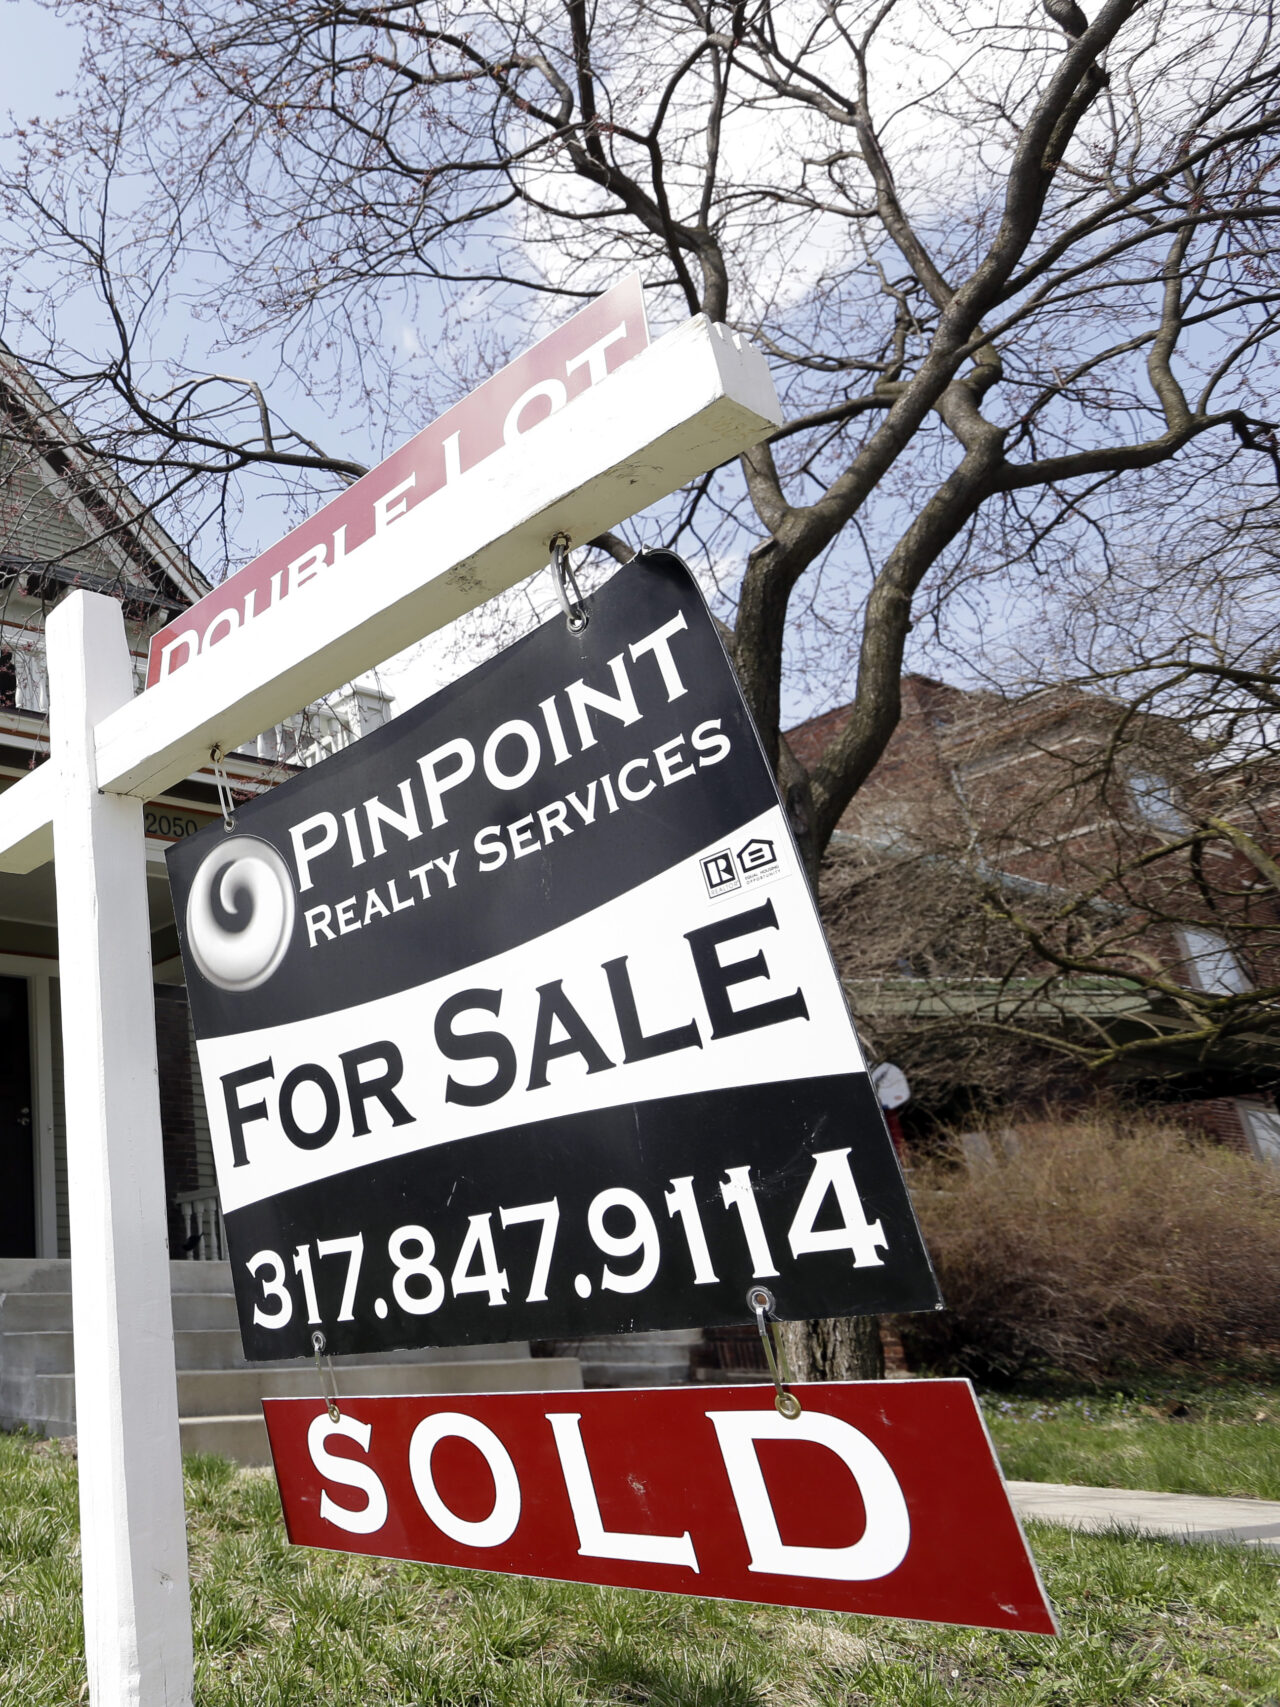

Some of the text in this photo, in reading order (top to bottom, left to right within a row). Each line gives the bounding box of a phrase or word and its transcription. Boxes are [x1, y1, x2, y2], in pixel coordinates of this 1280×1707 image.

[145, 812, 198, 838] 2050
[288, 609, 689, 893] PINPOINT
[303, 718, 731, 948] REALTY SERVICES
[220, 897, 810, 1168] FOR SALE
[245, 1147, 889, 1330] 317.847.9114
[307, 1411, 911, 1581] SOLD
